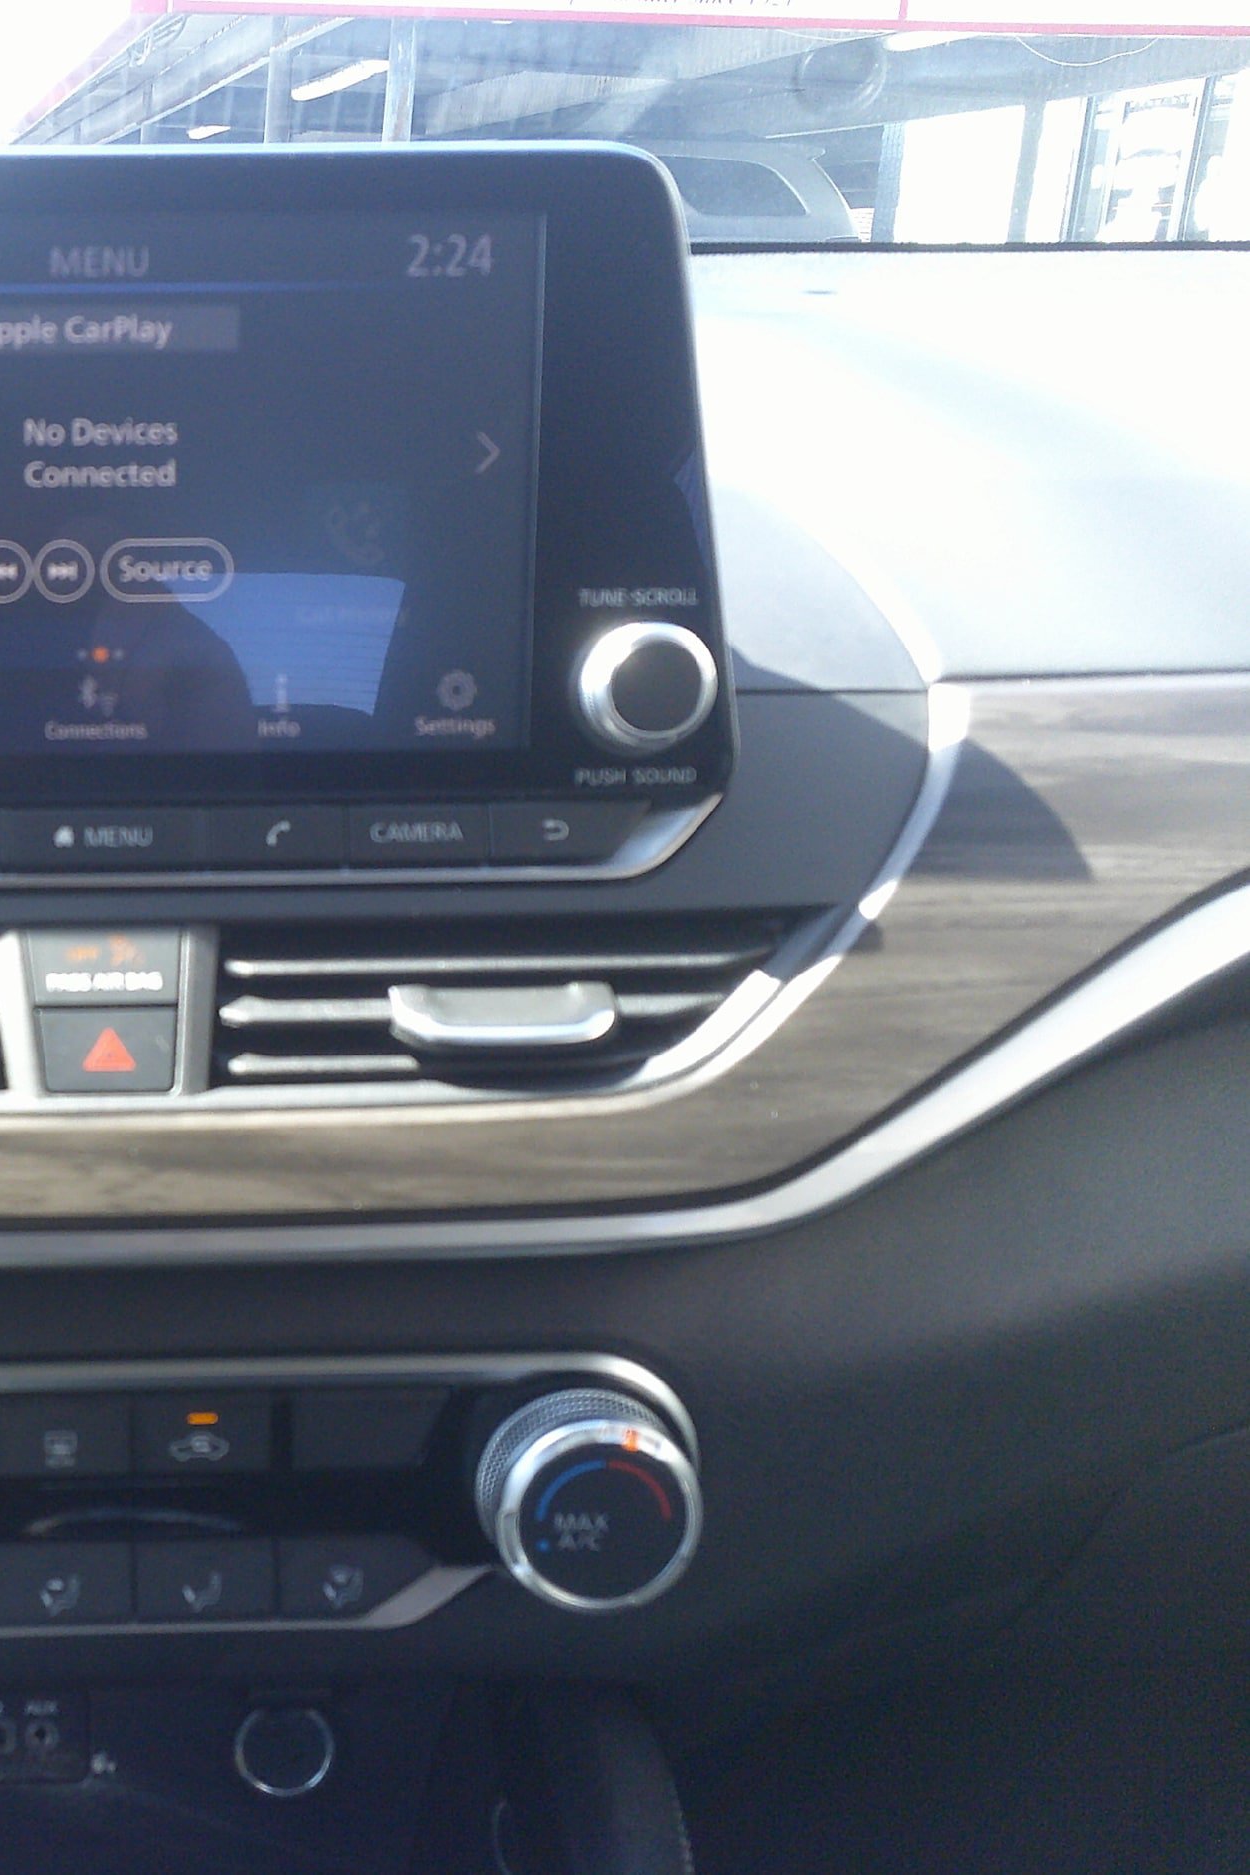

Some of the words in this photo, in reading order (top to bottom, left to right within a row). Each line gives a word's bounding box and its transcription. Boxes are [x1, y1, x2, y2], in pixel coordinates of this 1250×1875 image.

[51, 246, 151, 279] MENU
[408, 235, 494, 277] 2:24
[64, 315, 173, 348] CarPlay
[23, 418, 65, 446] No
[72, 418, 178, 446] Devices
[23, 460, 177, 488] Connected
[117, 556, 213, 584] Source
[257, 719, 301, 738] Info
[414, 715, 496, 738] Settings
[574, 767, 626, 786] PUSH
[632, 767, 697, 784] SOUND
[83, 825, 153, 848] MENU
[369, 823, 464, 844] CAMERA
